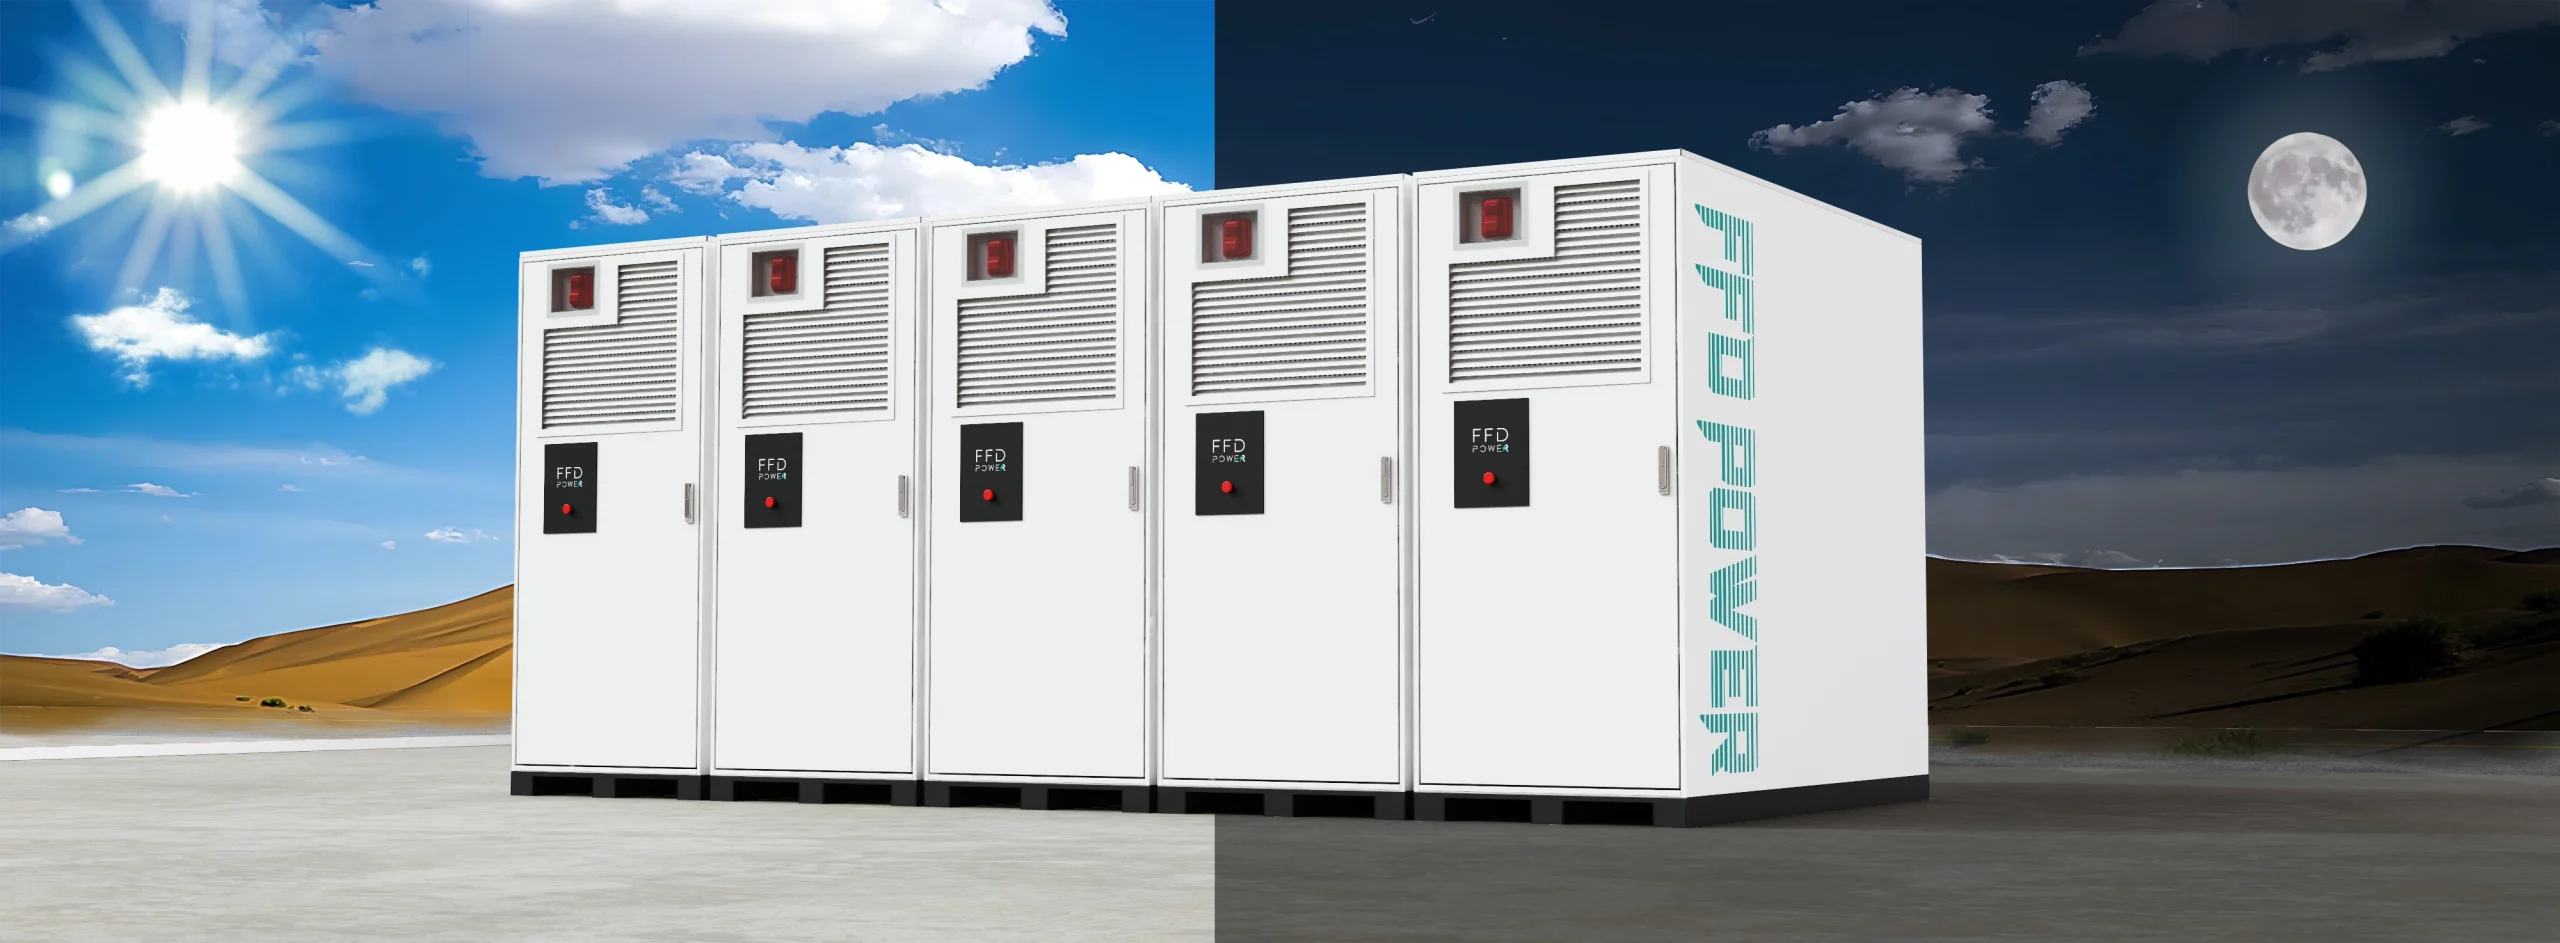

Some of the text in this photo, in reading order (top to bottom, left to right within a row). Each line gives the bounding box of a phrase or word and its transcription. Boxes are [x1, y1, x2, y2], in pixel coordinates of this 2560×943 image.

[1471, 427, 1510, 443] FFD
[1211, 438, 1246, 453] FFD
[1471, 444, 1510, 453] POWER
[974, 448, 1007, 463] FFD
[1211, 454, 1246, 463] POWER
[758, 457, 787, 472] FFD
[974, 464, 1007, 472] POWER
[556, 466, 584, 480] FFD
[758, 472, 787, 480] POWER
[556, 480, 584, 488] POWER
[1694, 202, 1759, 777] FFD POWER
